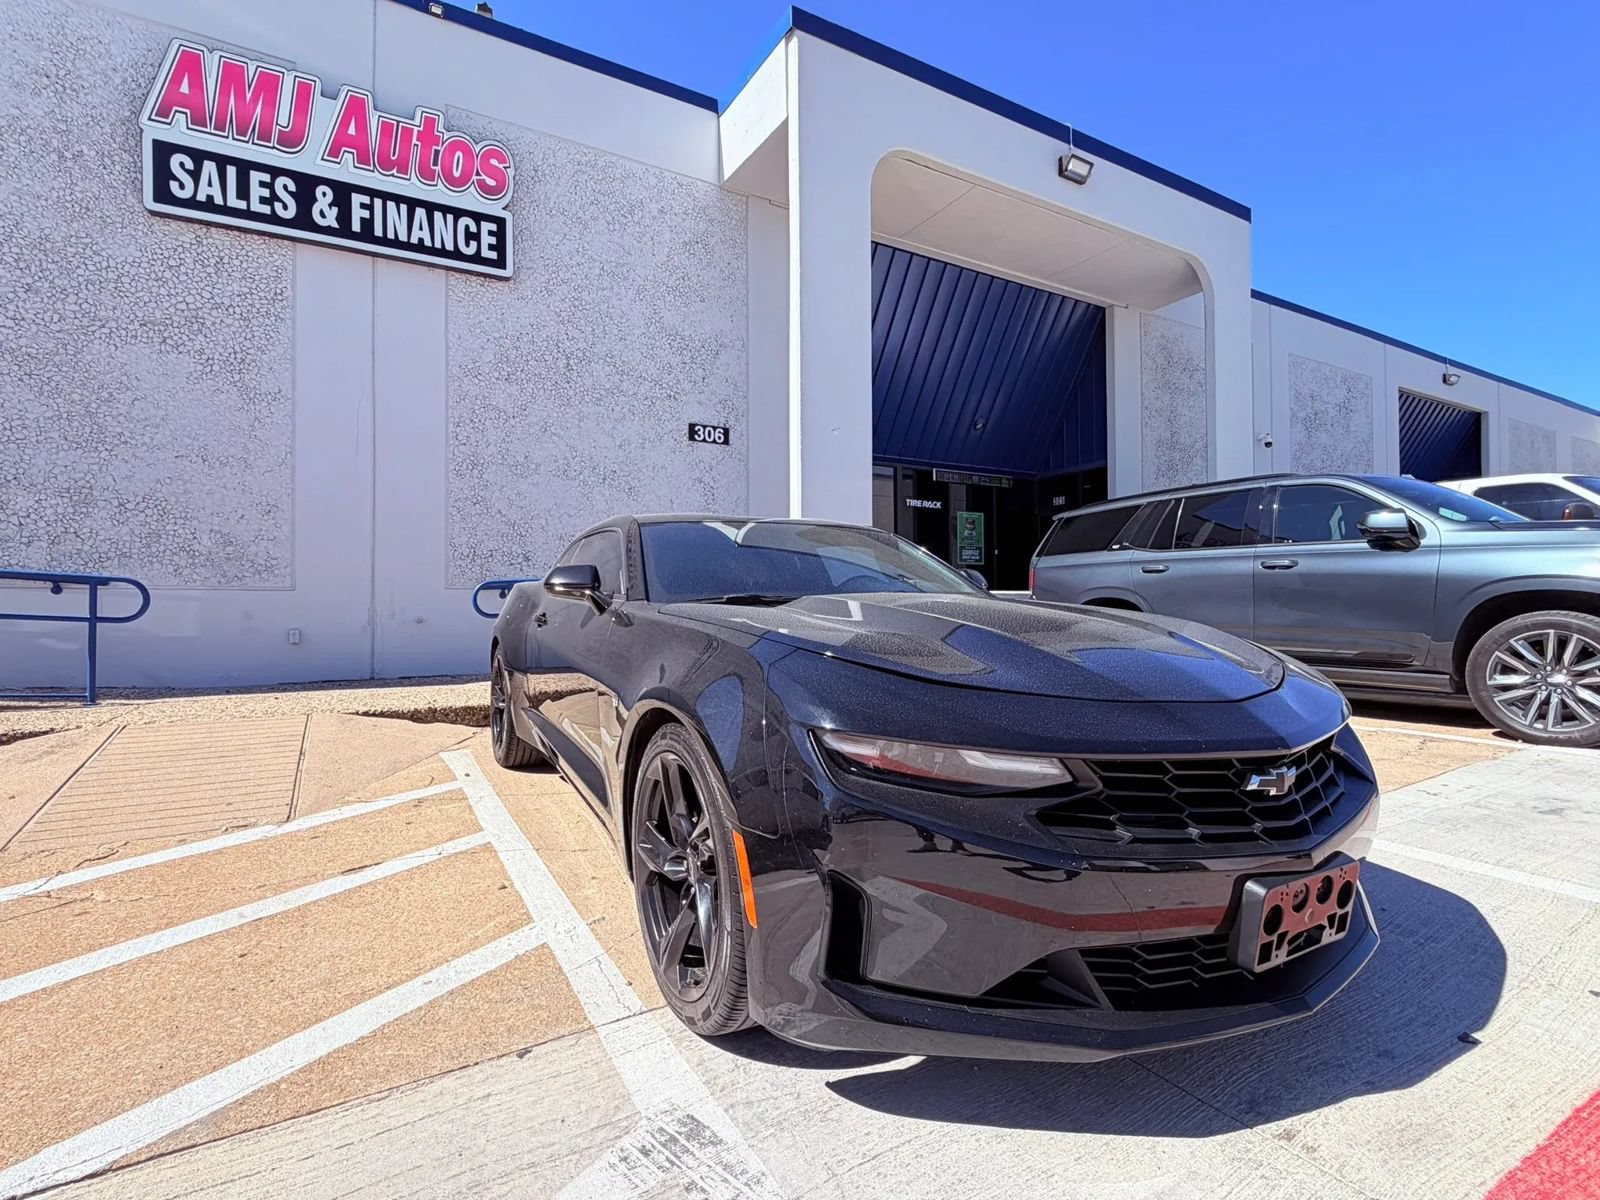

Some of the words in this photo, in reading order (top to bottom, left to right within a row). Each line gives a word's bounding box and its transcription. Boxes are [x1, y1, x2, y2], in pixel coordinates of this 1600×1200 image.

[149, 45, 318, 155] AMJ
[322, 90, 512, 200] Autos
[168, 152, 297, 220] SALES
[311, 184, 340, 229] &
[350, 194, 499, 260] FINANCE
[694, 425, 725, 444] 306
[906, 498, 922, 508] TIRE
